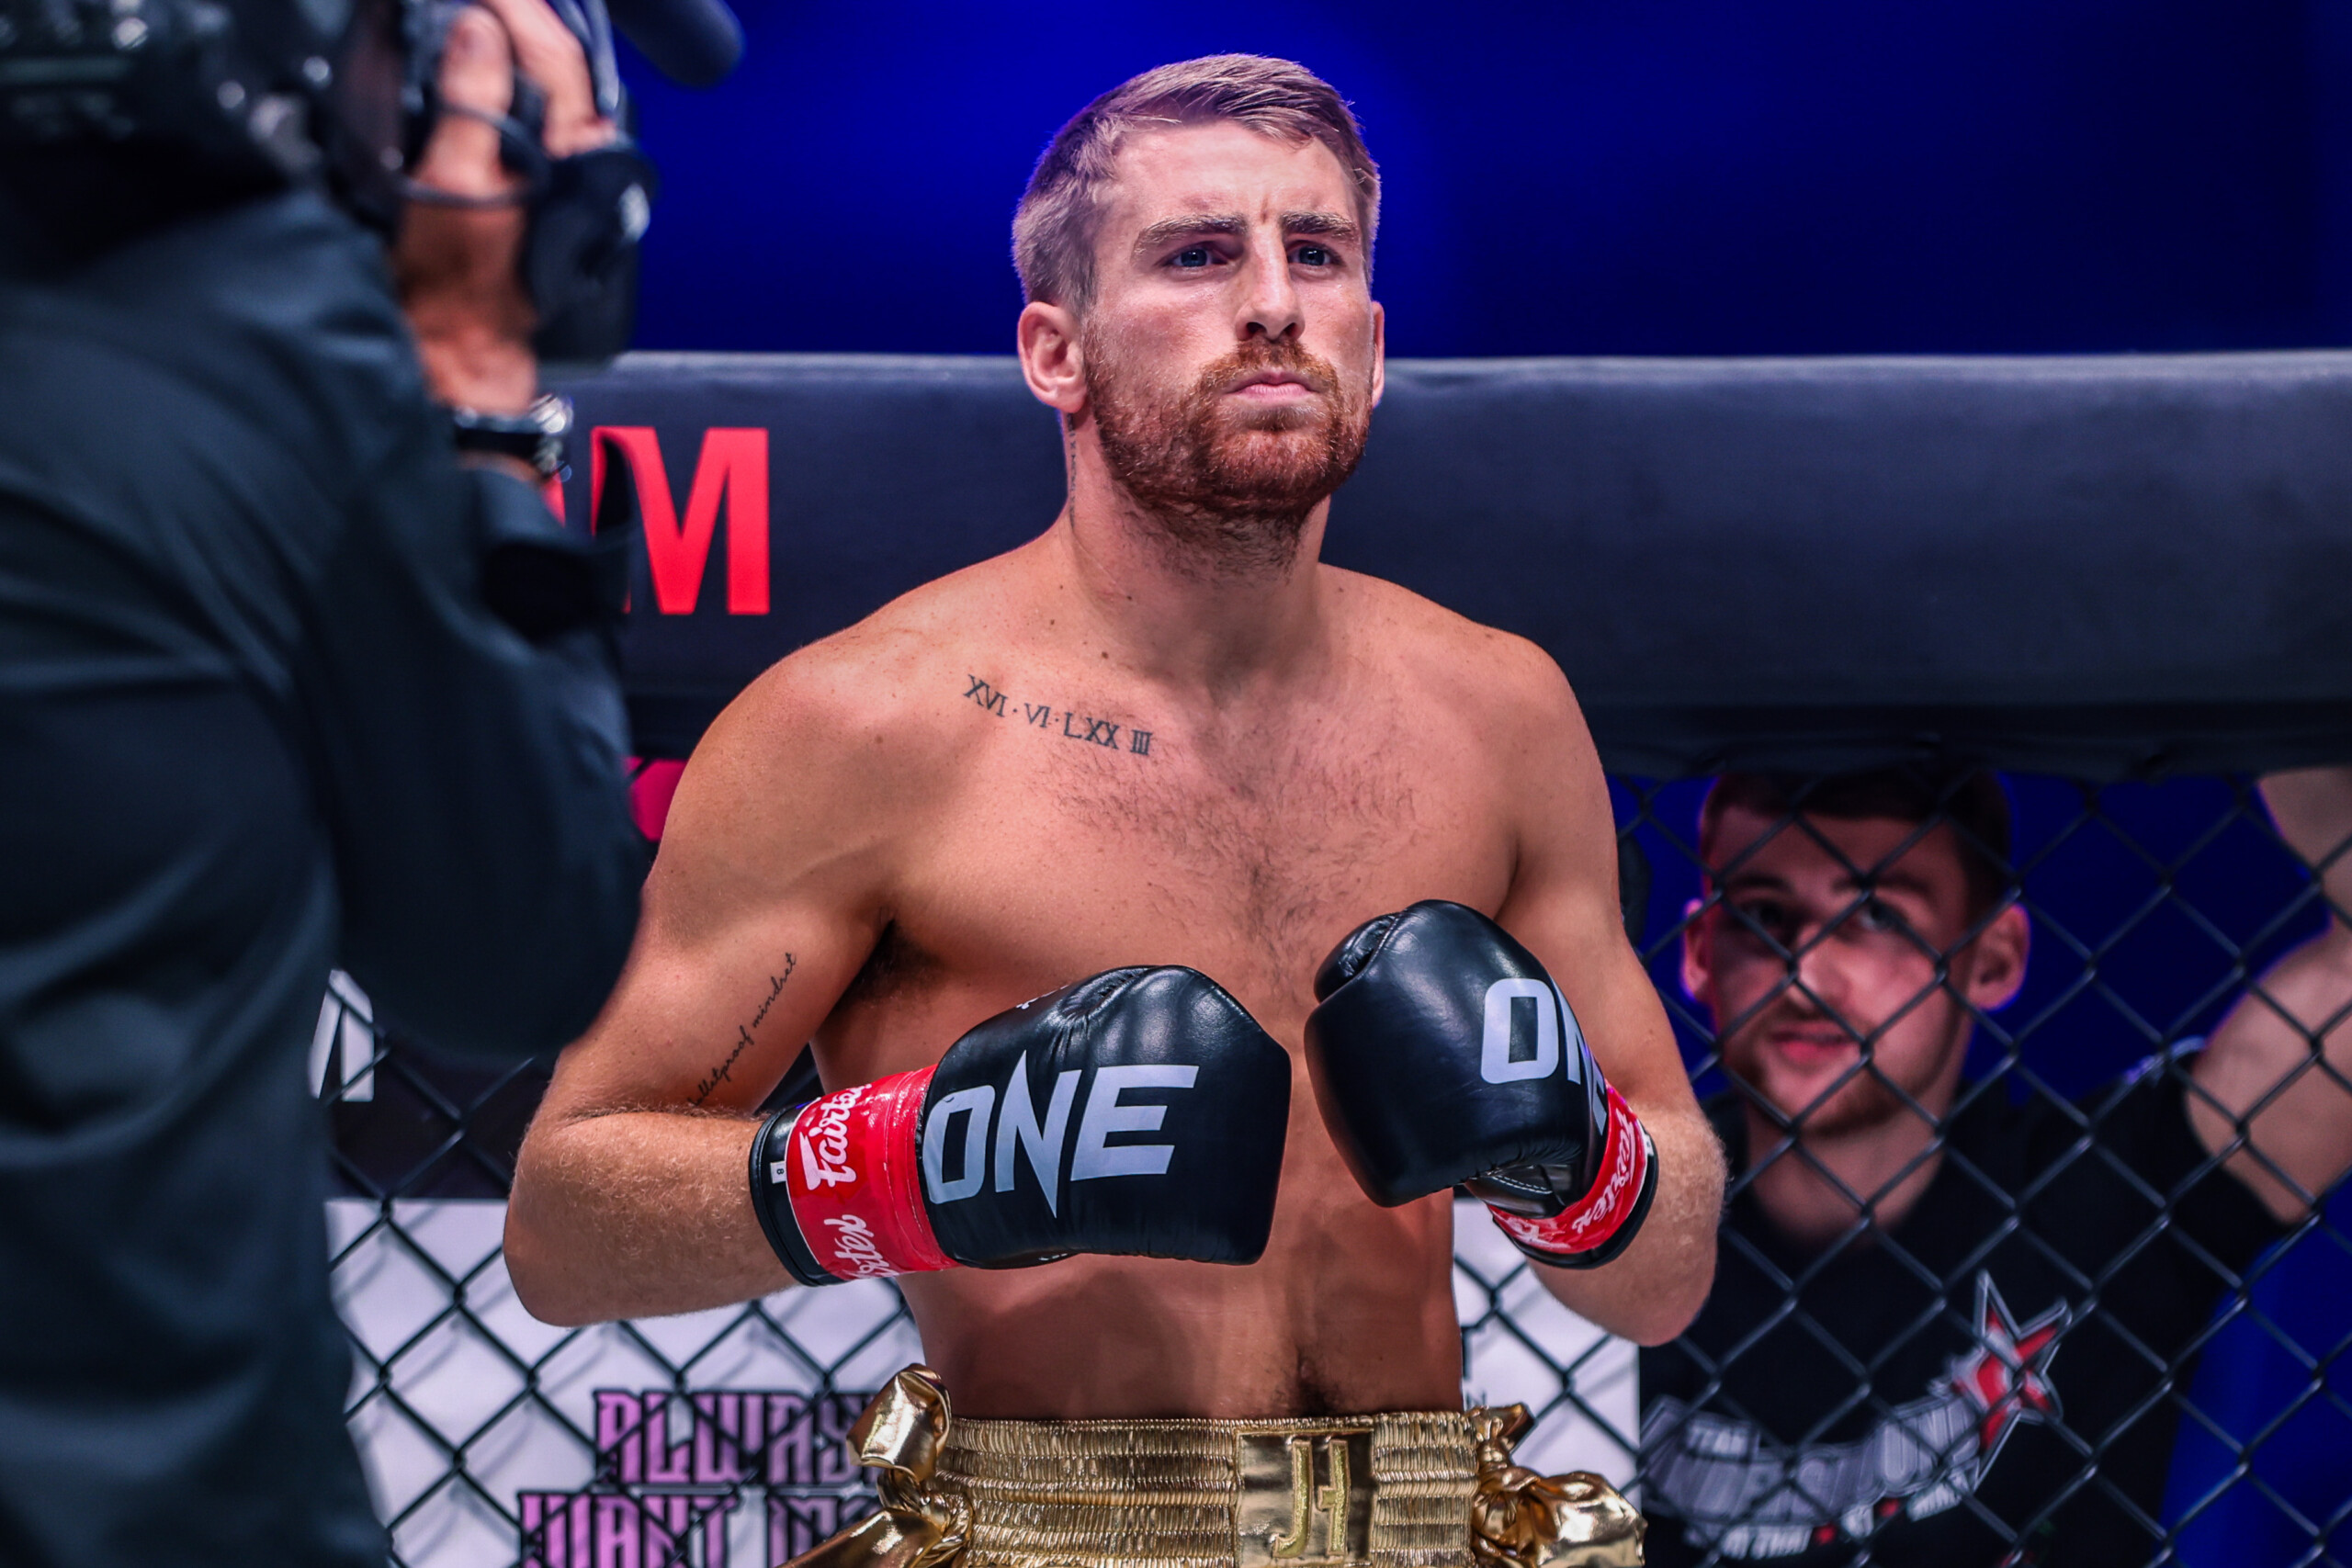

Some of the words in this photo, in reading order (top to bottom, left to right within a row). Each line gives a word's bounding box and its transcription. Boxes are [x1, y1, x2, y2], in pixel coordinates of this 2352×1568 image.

[541, 426, 770, 615] M
[922, 1050, 1200, 1219] ONE
[593, 1390, 879, 1484] ALWAY
